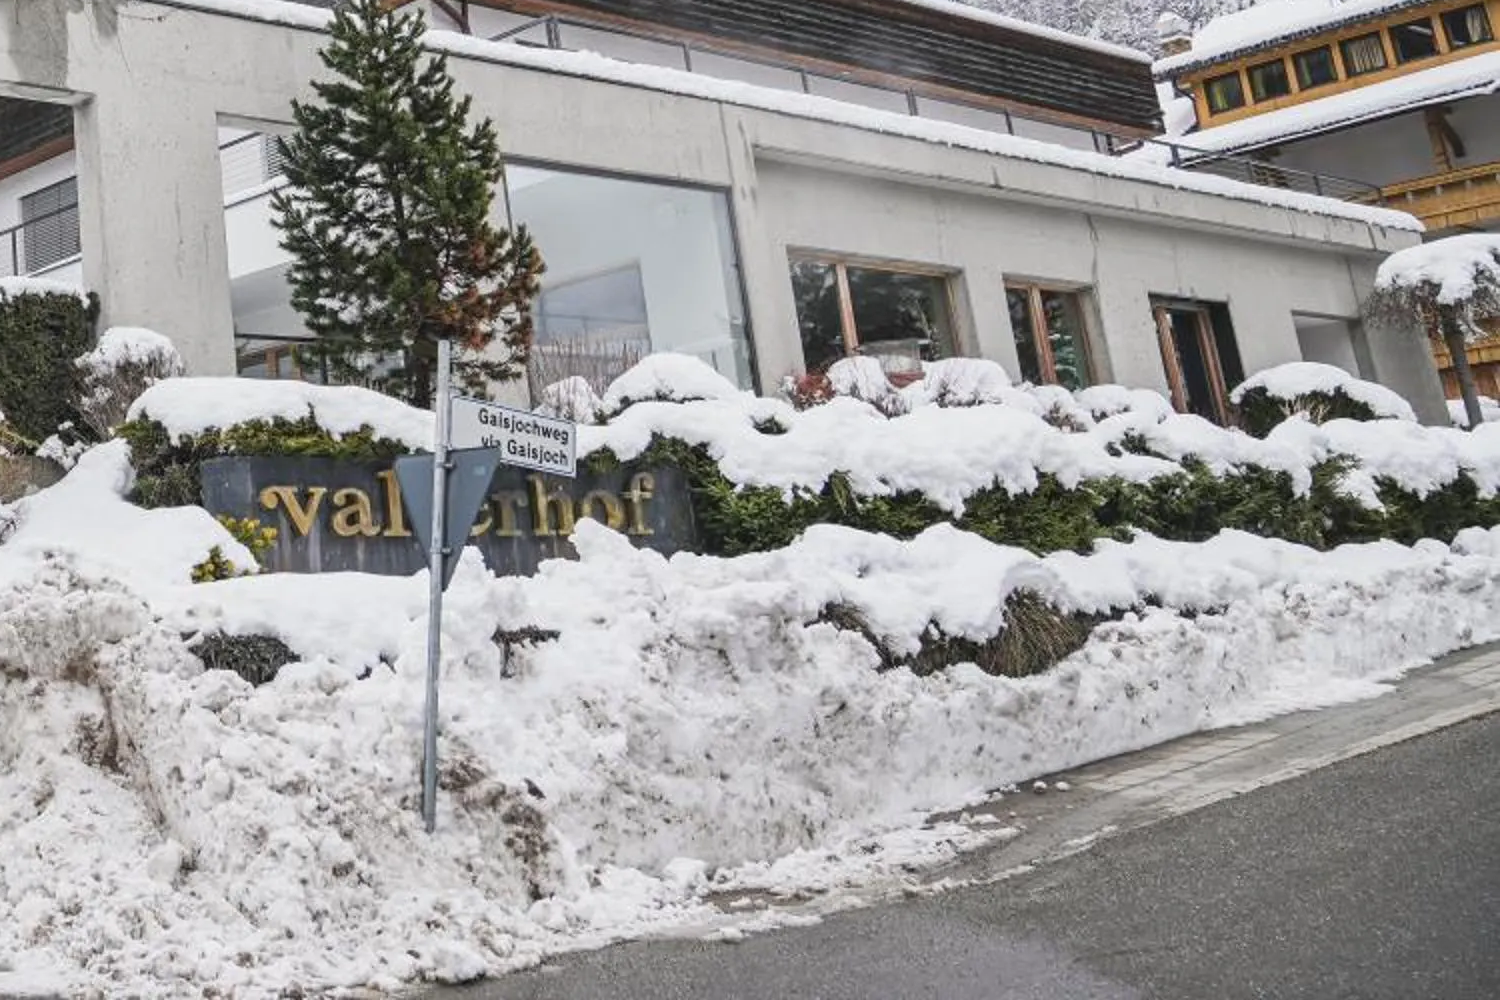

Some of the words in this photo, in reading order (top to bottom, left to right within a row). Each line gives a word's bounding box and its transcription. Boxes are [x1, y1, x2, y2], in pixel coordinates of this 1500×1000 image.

[478, 407, 569, 445] Gaisjochweg
[507, 439, 569, 465] Gaisjoch
[260, 469, 655, 537] valrhof
